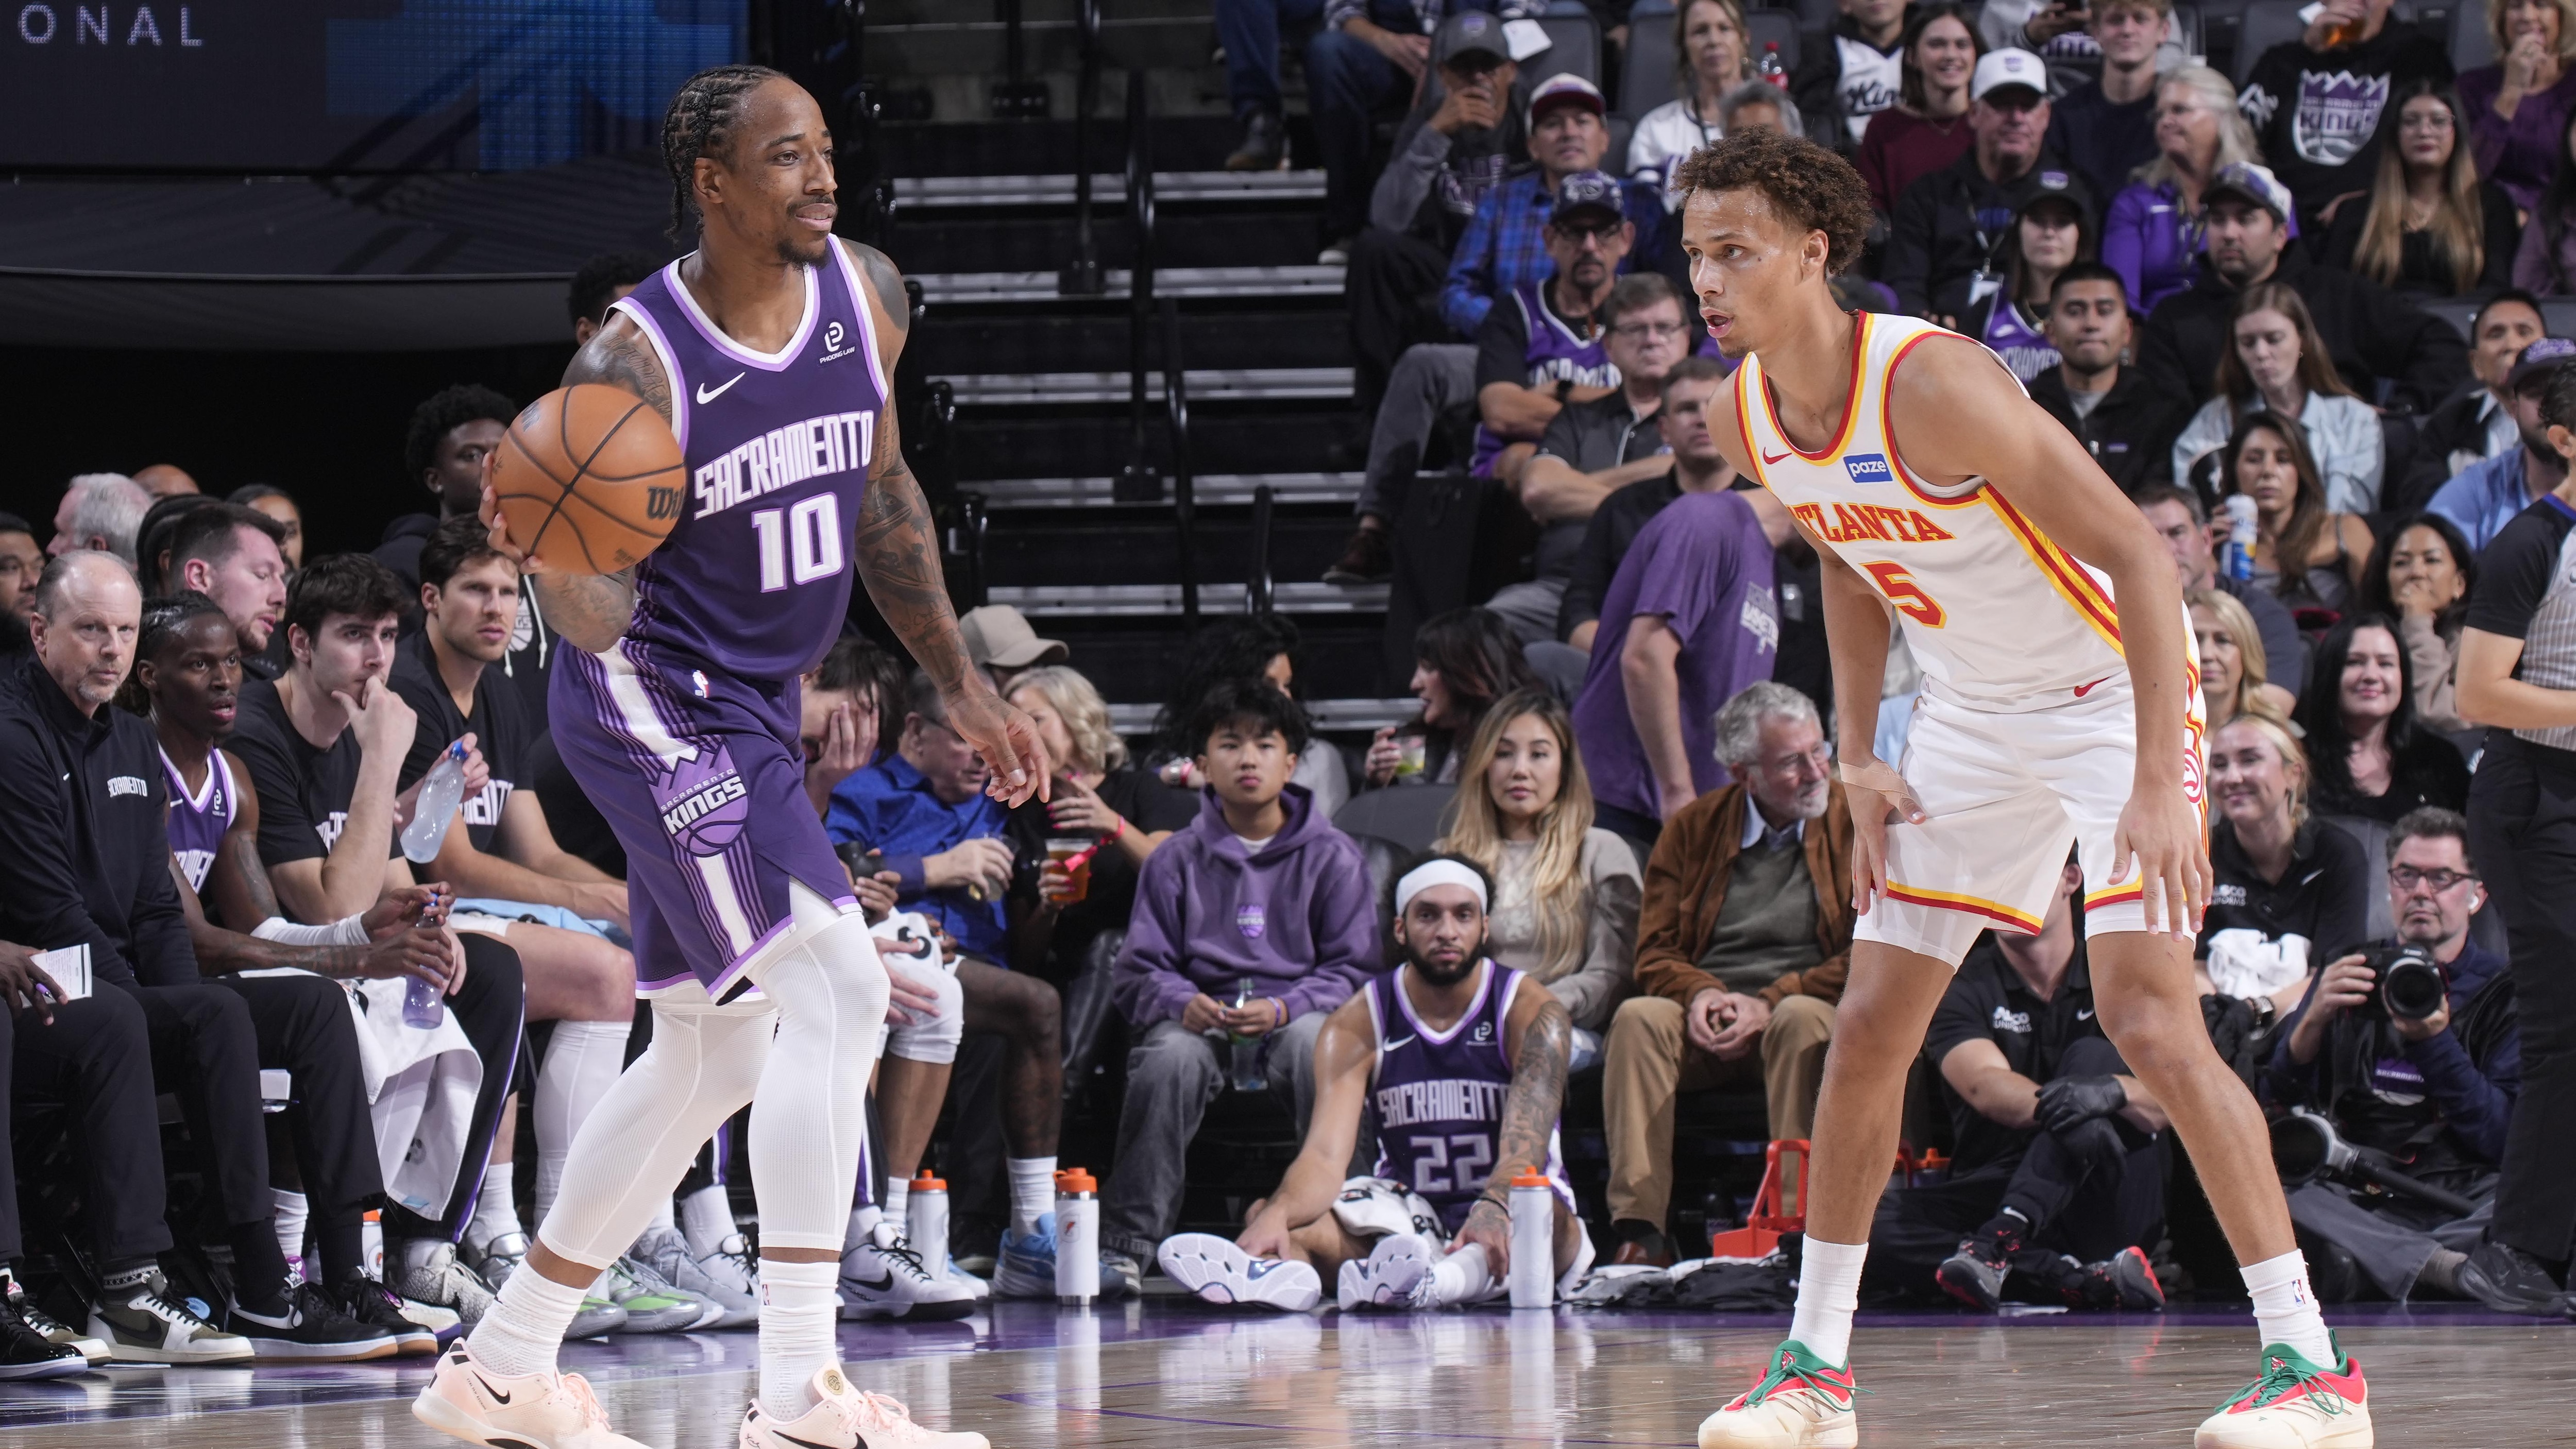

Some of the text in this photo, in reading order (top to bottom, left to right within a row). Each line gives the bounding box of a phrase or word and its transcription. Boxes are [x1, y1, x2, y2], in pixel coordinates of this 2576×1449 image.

[19, 4, 204, 46] ONAL
[819, 346, 855, 364] PHOONG LAW
[694, 410, 874, 521] SACRAMENTO
[1849, 461, 1887, 477] paze
[647, 486, 684, 520] Wil
[1786, 502, 1957, 542] TLANTA
[751, 491, 844, 592] 10
[1858, 560, 1947, 629] 5
[660, 768, 734, 812] SACRAMENTO
[663, 776, 747, 835] KINGS
[1409, 1134, 1491, 1192] 22
